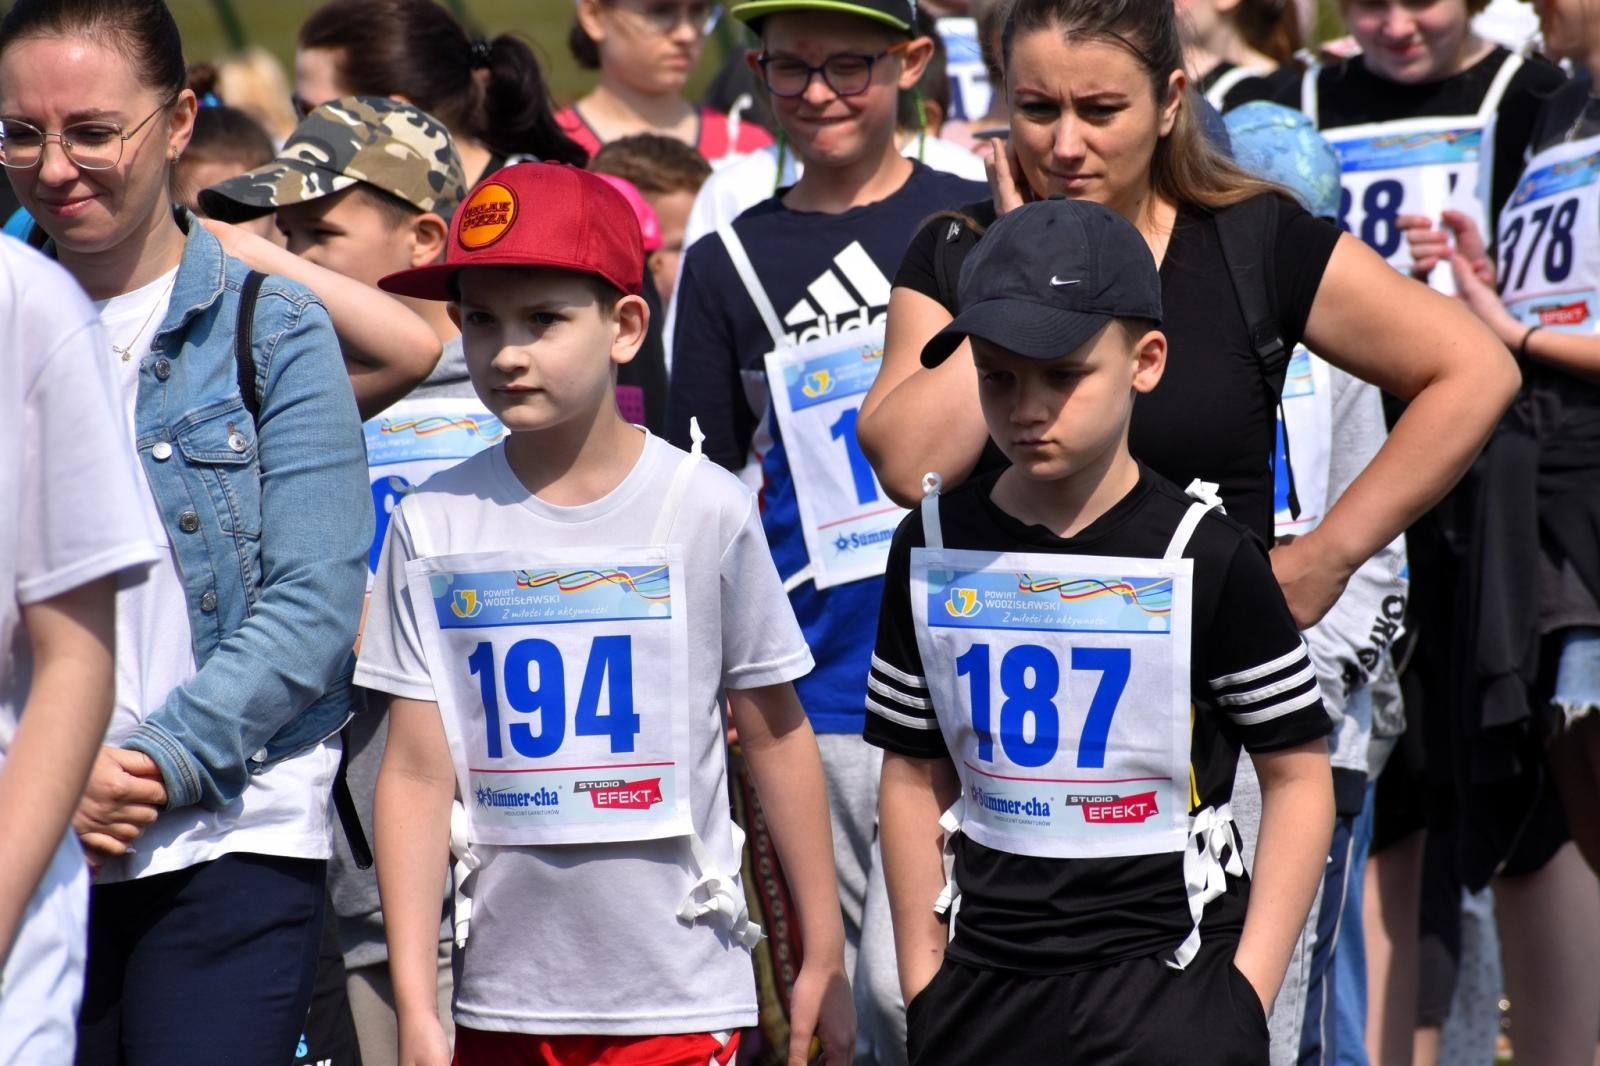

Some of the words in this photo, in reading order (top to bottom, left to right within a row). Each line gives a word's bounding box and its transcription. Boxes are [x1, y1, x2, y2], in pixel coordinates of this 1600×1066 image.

[1498, 197, 1580, 297] 378
[483, 588, 516, 598] POWIAT
[984, 591, 1017, 600] POWIAT
[502, 608, 510, 620] Z
[1002, 611, 1011, 623] Z
[468, 635, 640, 758] 194
[956, 643, 1132, 768] 187
[578, 781, 620, 789] STUDIO
[597, 789, 652, 805] EFEKT
[1089, 802, 1148, 820] EFEKT
